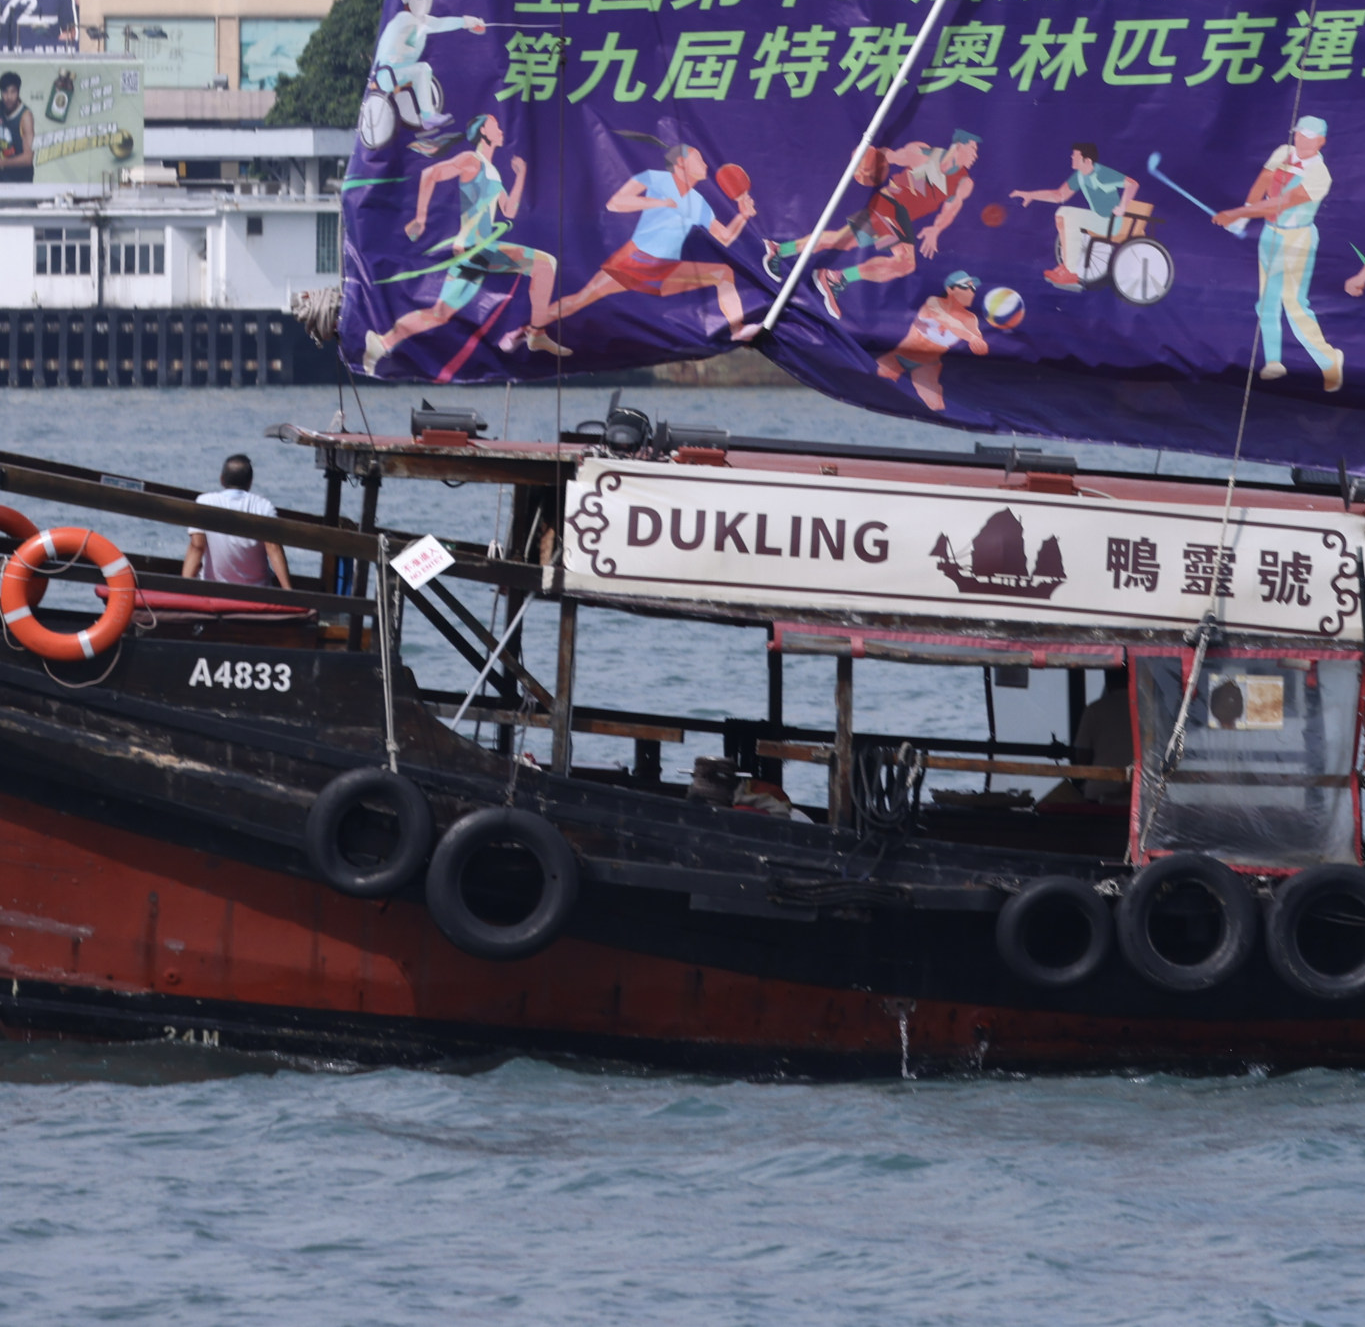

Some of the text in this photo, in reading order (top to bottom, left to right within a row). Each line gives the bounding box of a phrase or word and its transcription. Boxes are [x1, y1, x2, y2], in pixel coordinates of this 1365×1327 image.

[626, 505, 1314, 607] DUKLING 鴨靈號
[188, 657, 292, 693] A4833
